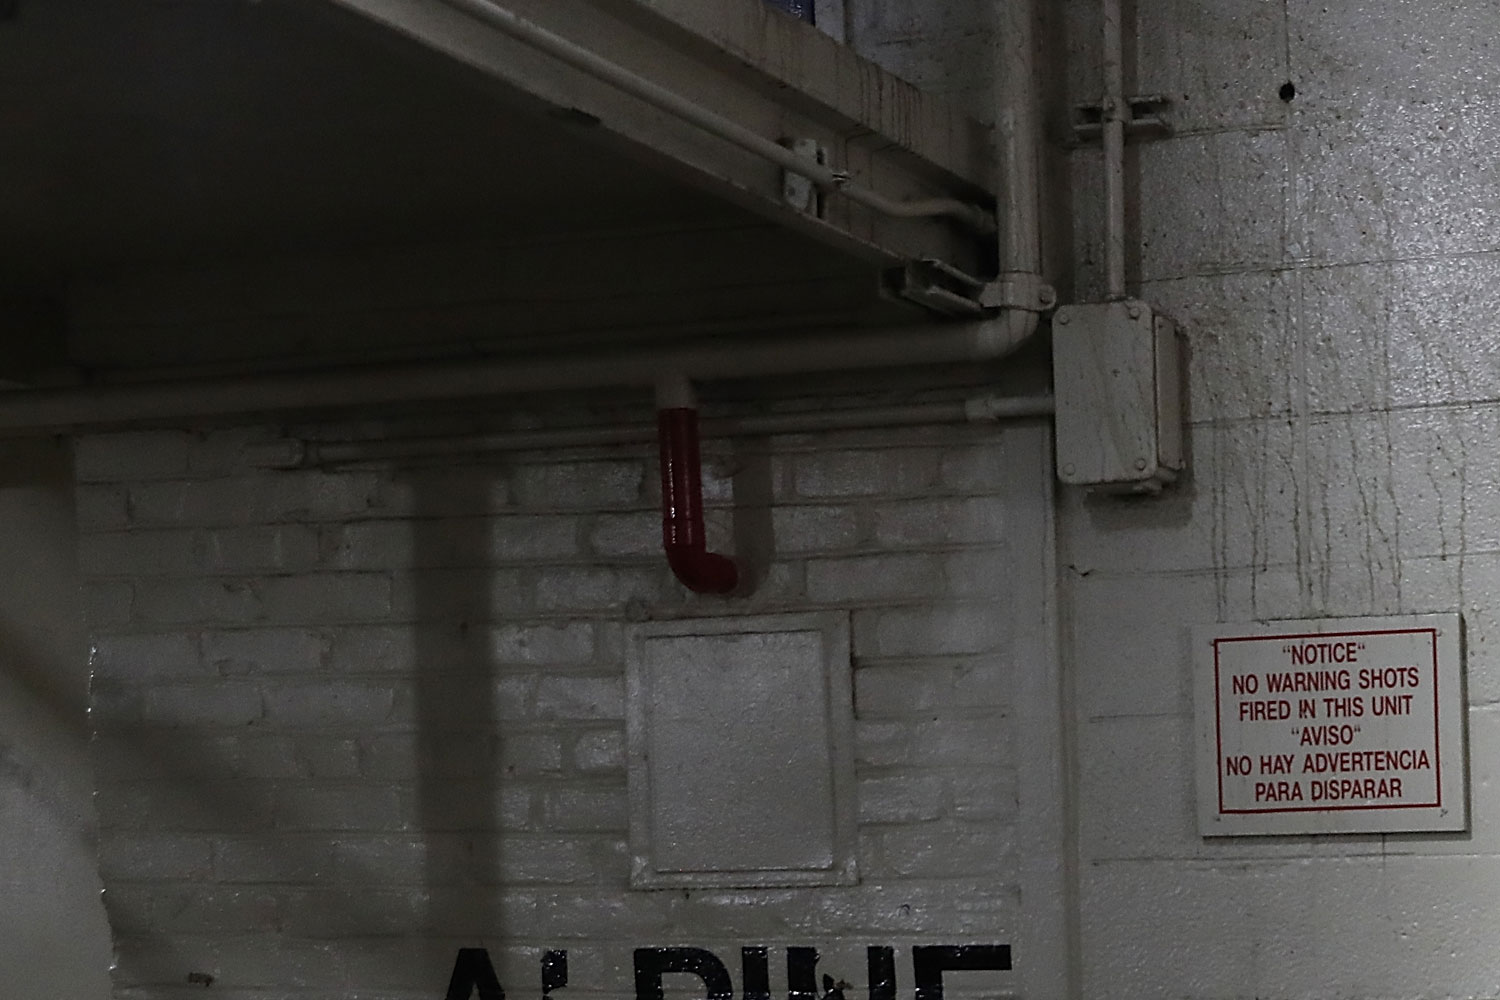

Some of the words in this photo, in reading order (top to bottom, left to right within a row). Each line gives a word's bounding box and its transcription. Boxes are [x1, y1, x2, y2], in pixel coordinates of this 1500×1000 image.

[1232, 674, 1258, 695] NO
[1266, 670, 1350, 694] WARNING
[1358, 667, 1419, 690] SHOTS
[1239, 700, 1291, 721] FIRED
[1299, 699, 1316, 719] IN
[1323, 697, 1364, 718] THIS
[1372, 695, 1413, 716] UNIT
[1226, 755, 1251, 776] NO
[1260, 754, 1295, 775] HAY
[1303, 750, 1430, 773] ADVERTENCIA
[1255, 781, 1303, 802] PARA
[1311, 778, 1402, 801] DISPARAR
